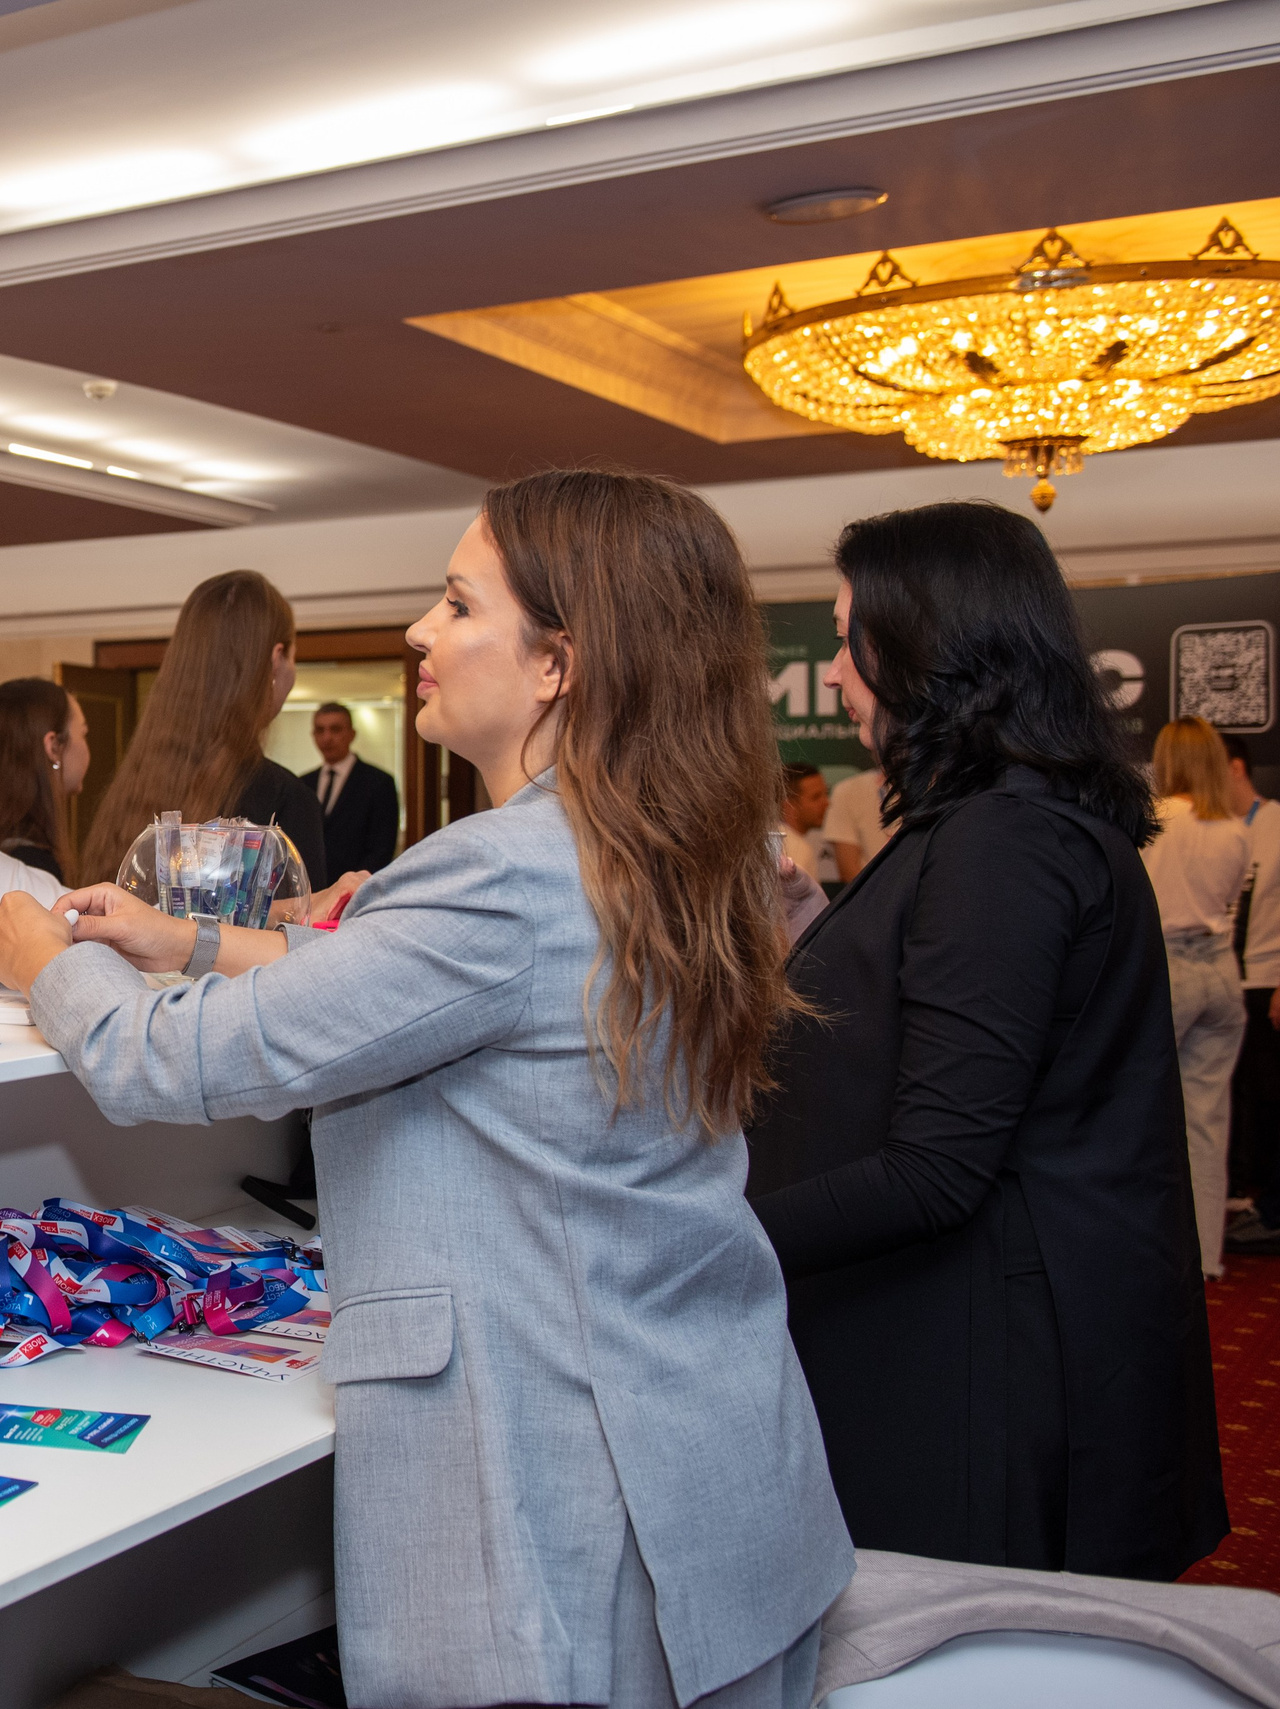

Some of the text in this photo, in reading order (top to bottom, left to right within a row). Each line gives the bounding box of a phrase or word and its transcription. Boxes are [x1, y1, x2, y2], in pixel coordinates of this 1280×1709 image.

[40, 1224, 58, 1233] OEX
[93, 1213, 116, 1226] MOEX
[53, 1275, 77, 1295] MOEX
[23, 1334, 46, 1354] MOEX
[152, 1344, 290, 1381] УЧАСТНИК
